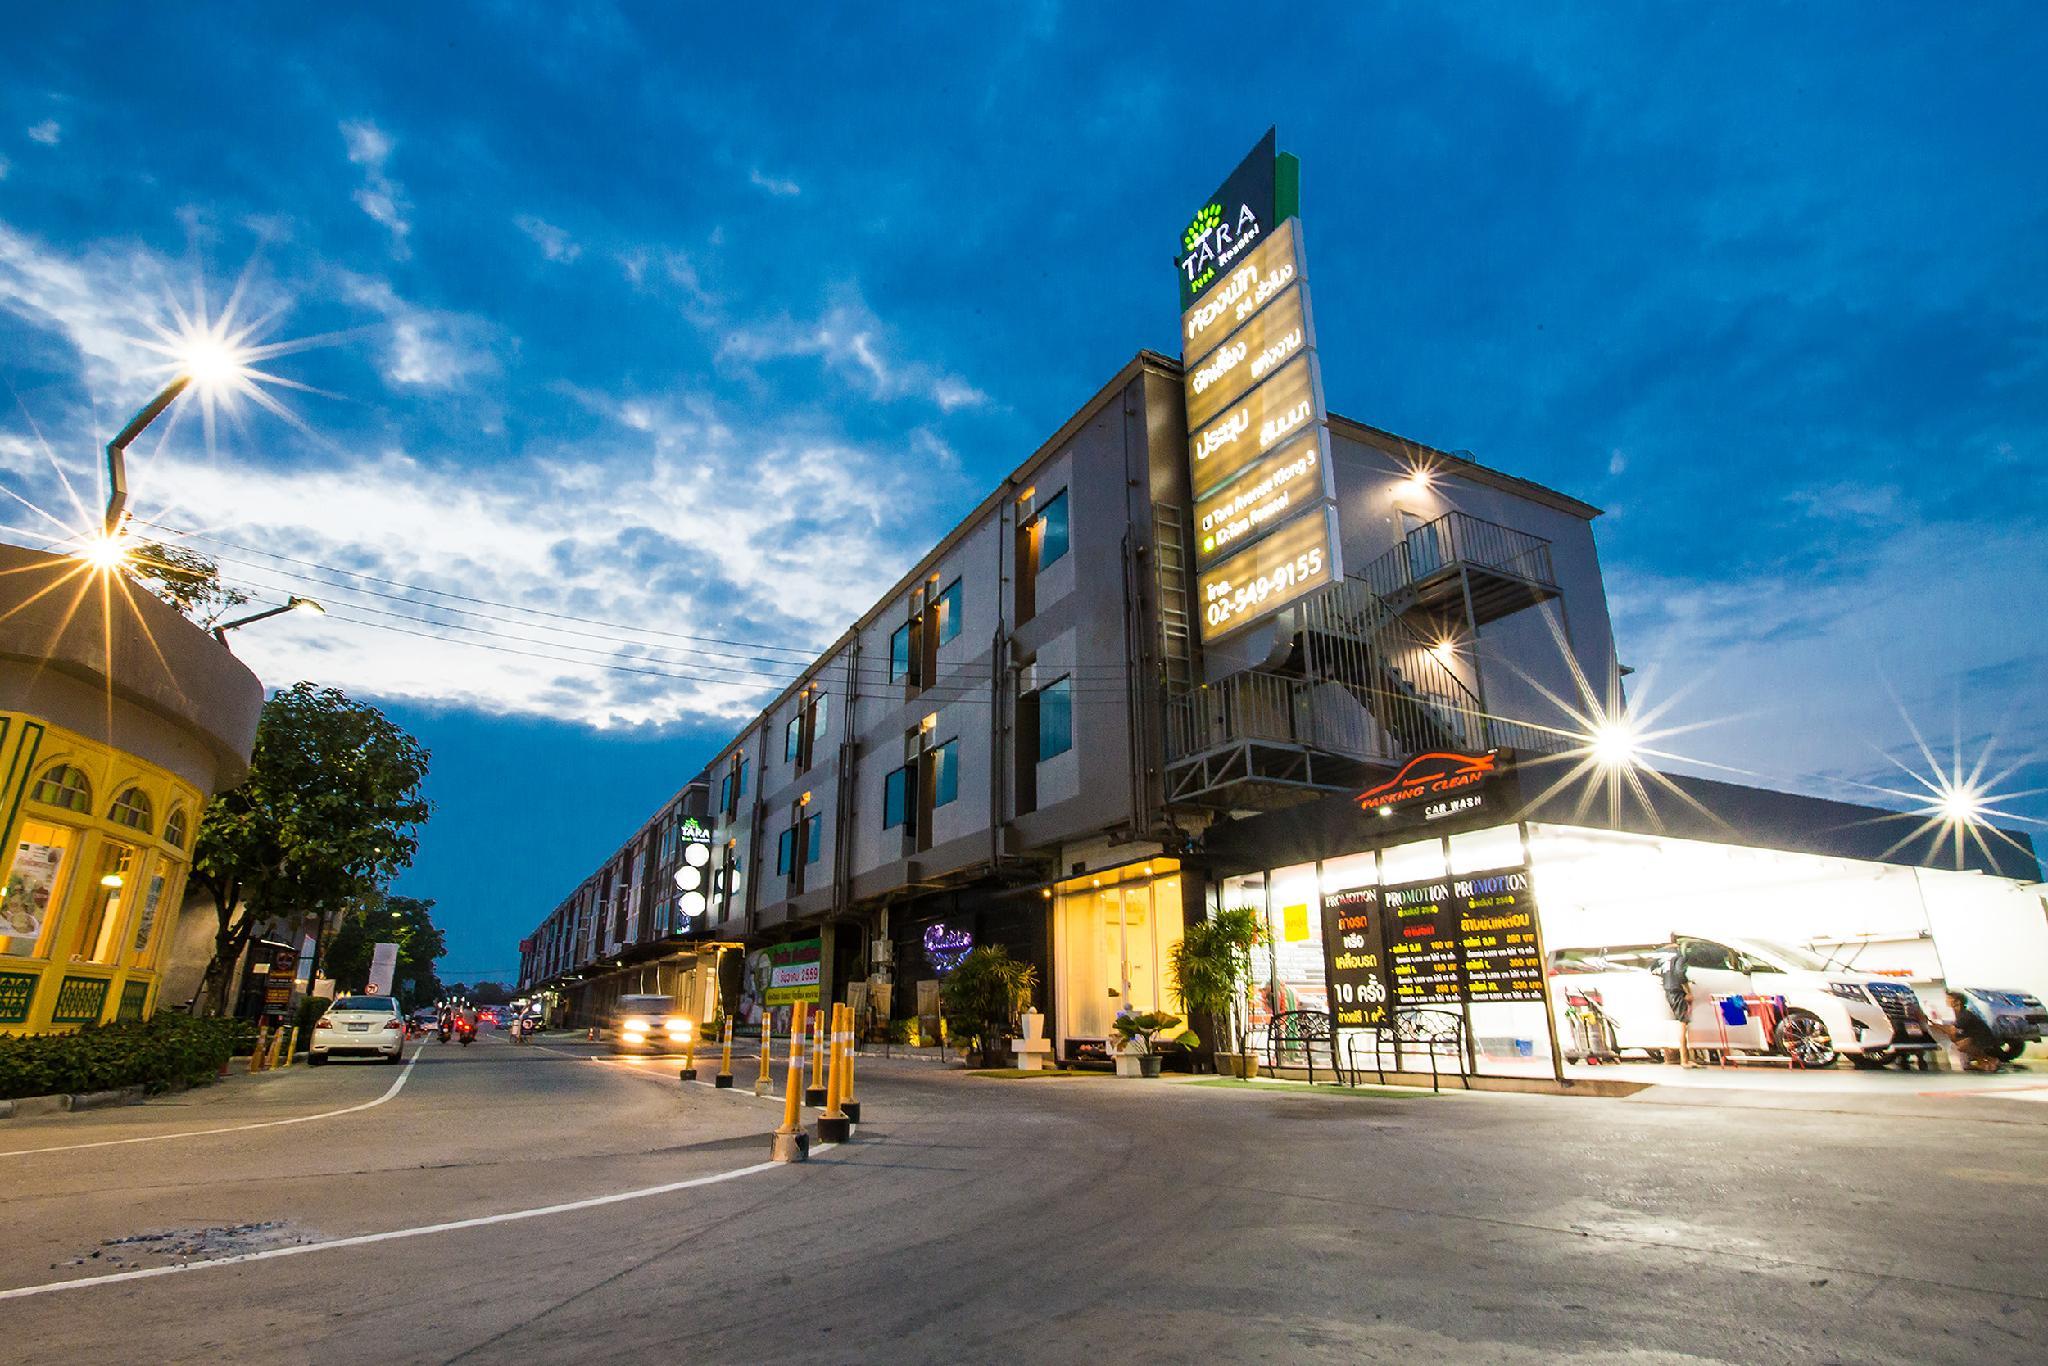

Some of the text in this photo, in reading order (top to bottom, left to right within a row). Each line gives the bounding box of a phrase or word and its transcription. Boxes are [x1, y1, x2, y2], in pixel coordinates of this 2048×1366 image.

[1182, 204, 1256, 281] TARA
[1361, 771, 1483, 810] PARKING CLEAN
[1424, 795, 1482, 816] CAR WASH
[1384, 884, 1450, 908] PROMOTION
[1454, 873, 1528, 898] PROMOTION
[1324, 889, 1377, 908] PROMOTION
[1333, 983, 1353, 1003] 10
[1356, 973, 1386, 1003] ครั้ง
